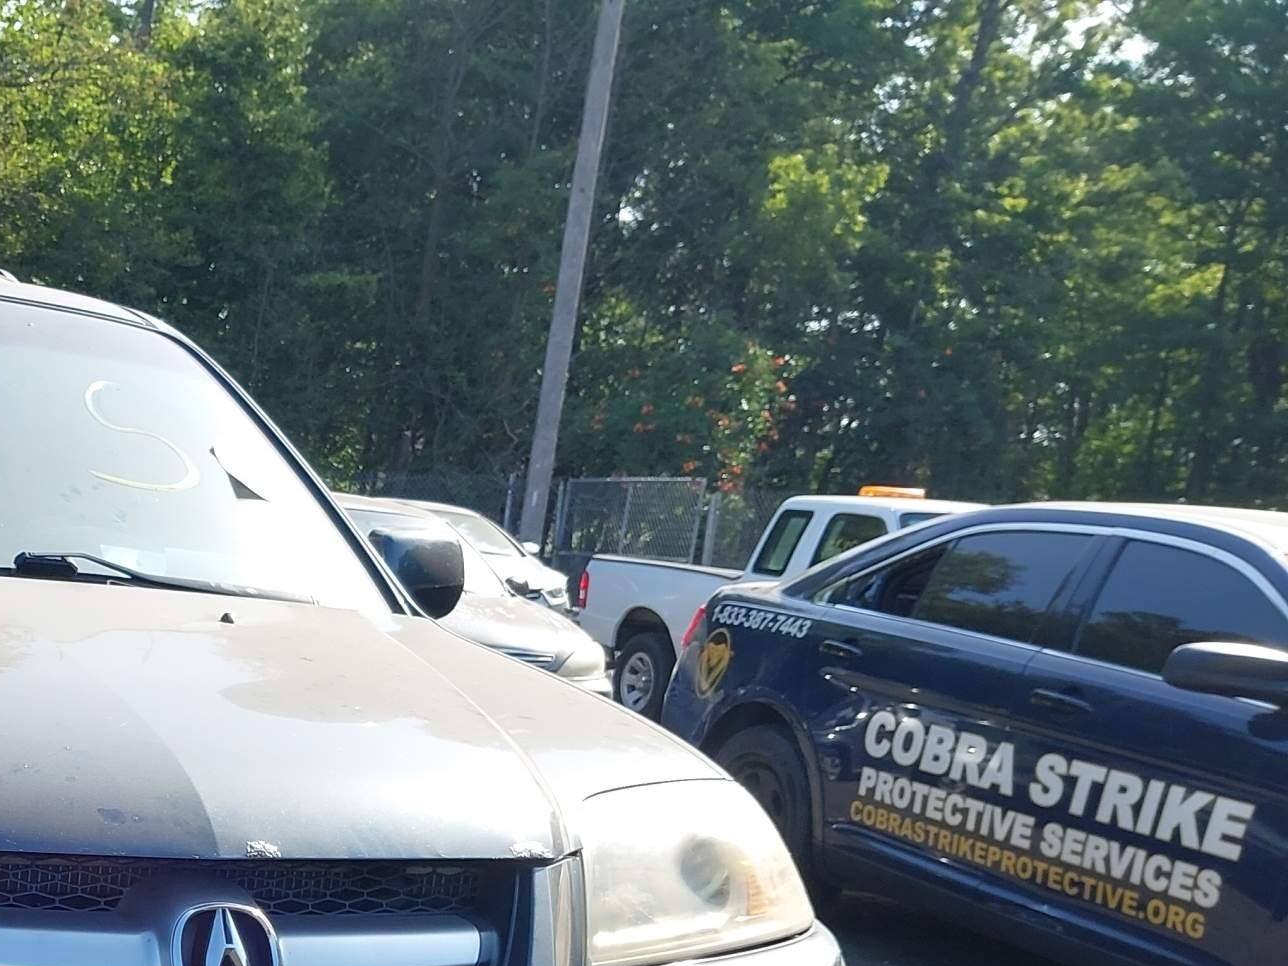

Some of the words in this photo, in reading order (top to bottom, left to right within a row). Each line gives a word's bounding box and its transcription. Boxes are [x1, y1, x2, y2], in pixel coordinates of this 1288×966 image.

[858, 766, 1036, 850] PROTECTIVE
[1039, 822, 1223, 909] SERVICES
[864, 710, 1015, 798] COBRA
[1028, 752, 1256, 863] STRIKE
[849, 800, 1206, 940] COBRASTRIKEPROTECTIVE.ORG
